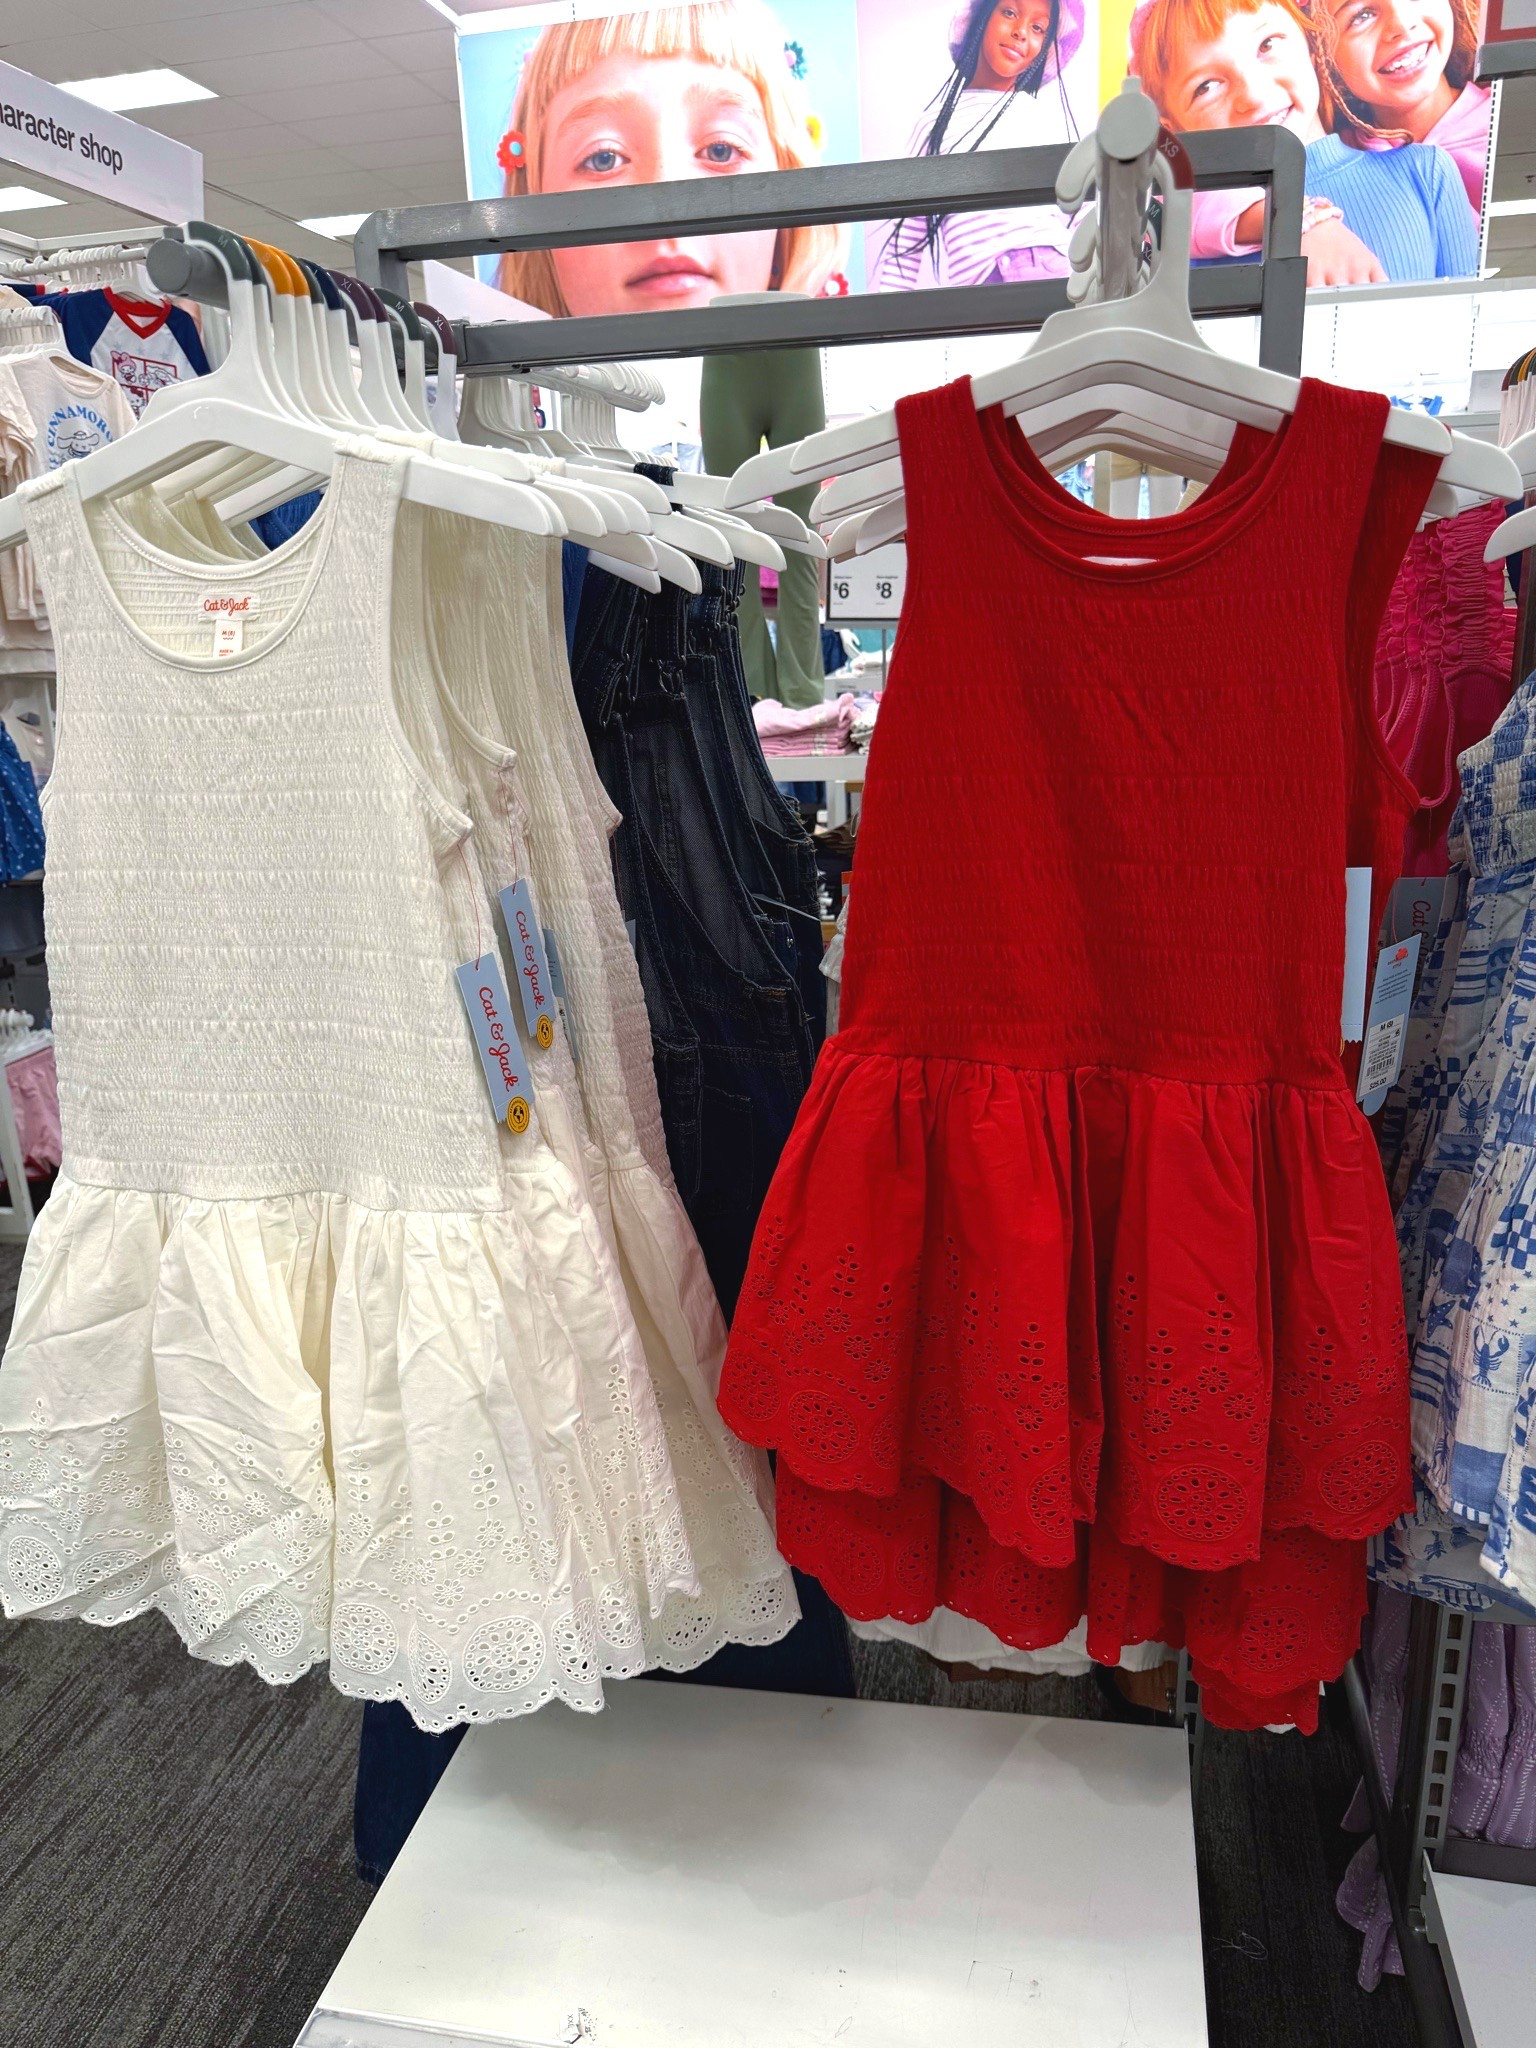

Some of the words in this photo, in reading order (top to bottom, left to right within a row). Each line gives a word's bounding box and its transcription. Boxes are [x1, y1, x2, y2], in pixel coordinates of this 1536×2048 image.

[80, 133, 123, 175] shop
[1160, 138, 1179, 158] XS
[1149, 204, 1160, 217] M
[341, 278, 352, 292] XL
[396, 302, 405, 312] M
[435, 317, 443, 330] XL
[833, 581, 850, 600] $6
[876, 581, 893, 600] $8
[204, 599, 220, 611] Cat
[220, 599, 228, 610] &
[228, 598, 249, 616] Jack
[1412, 900, 1432, 928] Cat
[515, 910, 531, 944] Cat
[523, 944, 535, 963] &
[523, 963, 546, 1010] Jack
[478, 986, 498, 1022] Cat
[490, 1022, 504, 1042] &
[488, 1042, 519, 1093] Jack
[567, 2013, 575, 2029] XXL
